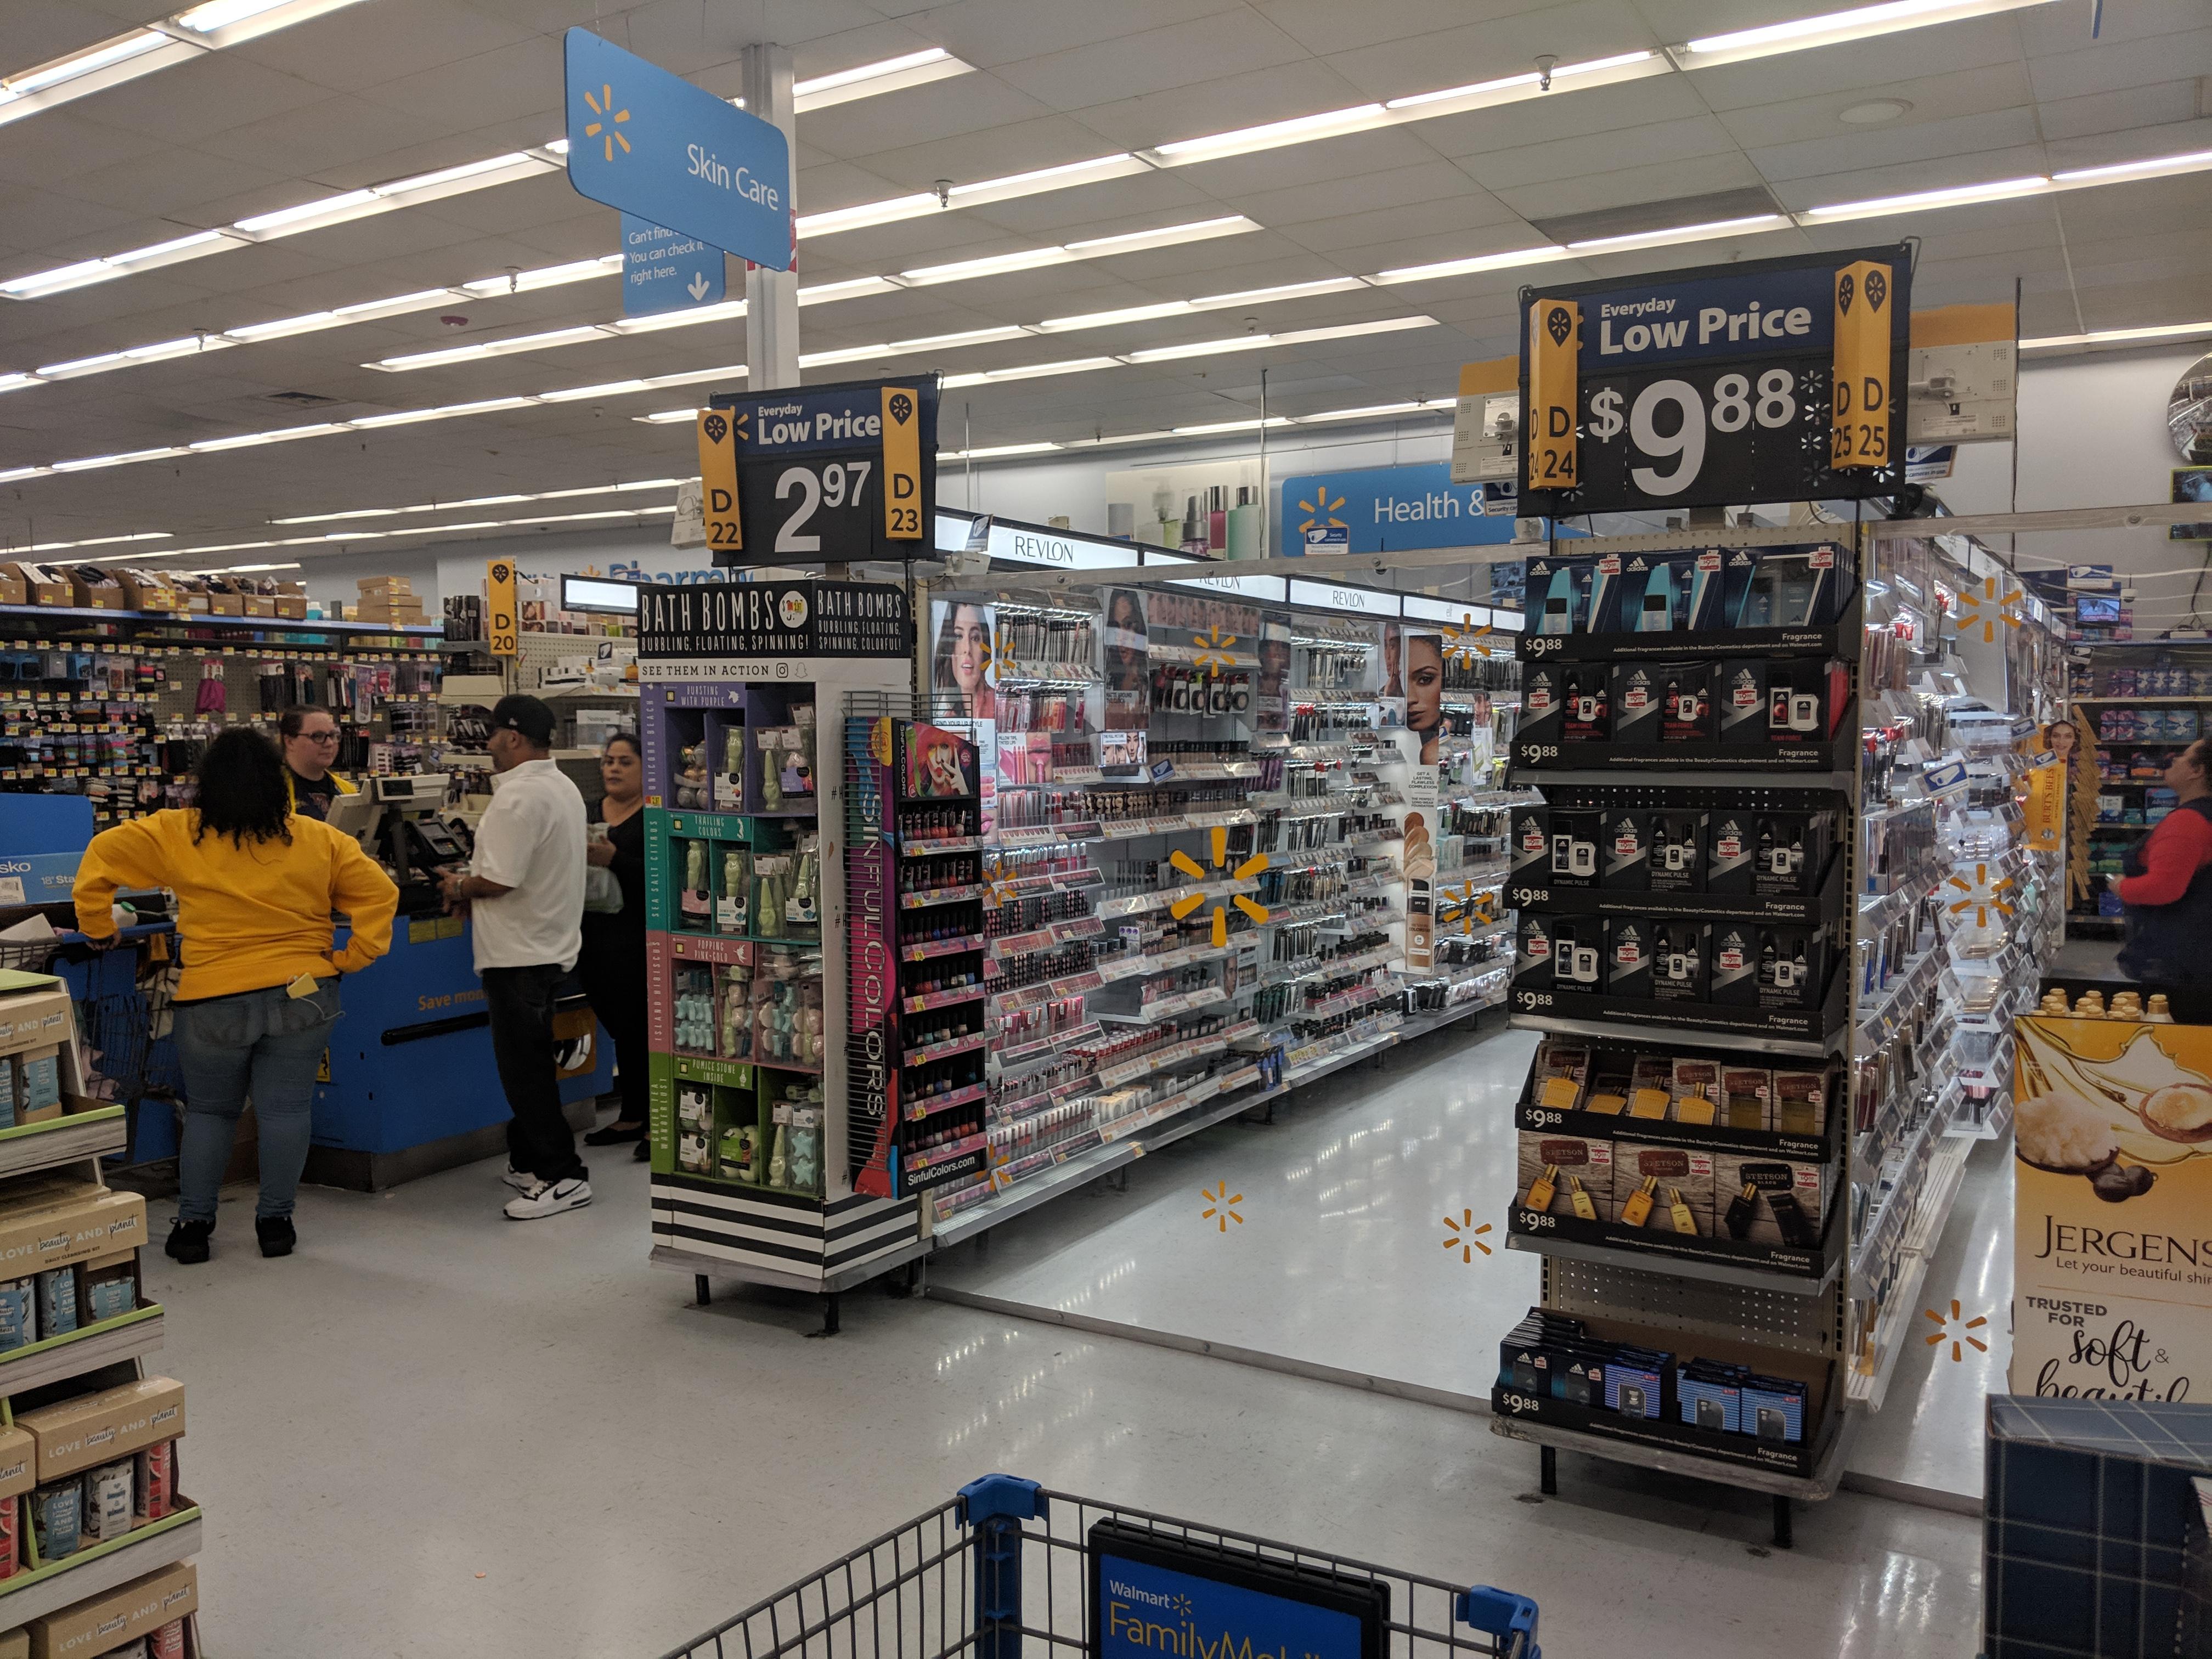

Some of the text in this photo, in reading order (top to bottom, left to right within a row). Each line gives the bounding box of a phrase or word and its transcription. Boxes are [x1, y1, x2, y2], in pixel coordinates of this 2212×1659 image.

[687, 144, 778, 211] Skin Care
[629, 229, 652, 245] Can't
[629, 252, 647, 264] You
[649, 248, 665, 260] can
[668, 240, 695, 256] check
[630, 266, 678, 285] right here.
[1601, 297, 1676, 319] Everyday
[1600, 302, 1812, 356] Low Price
[1837, 382, 1851, 416] D
[1864, 377, 1883, 411] D
[758, 404, 803, 417] Everyday
[1549, 406, 1570, 437] D
[758, 410, 881, 445] Low Price
[1532, 408, 1538, 440] D
[1833, 427, 1852, 459] 25
[1858, 426, 1884, 458] 25
[1544, 449, 1573, 479] 24
[893, 473, 914, 499] D
[711, 489, 732, 512] D
[1374, 488, 1485, 524] Health &
[891, 509, 918, 532] 23
[710, 522, 738, 544] 22
[1015, 535, 1074, 563] REVLON
[817, 590, 851, 617] BATH
[858, 592, 901, 618] BOMBS
[1333, 590, 1365, 608] REVLON
[495, 614, 510, 630] D
[642, 593, 691, 633] BATH
[702, 590, 774, 631] BOMBS
[818, 620, 860, 634] BUBBLING,
[1782, 633, 1822, 642] Fragrance
[494, 636, 514, 651] 20
[642, 634, 809, 652] BUBBLING, FLOATING, SPINNING!
[819, 636, 901, 651] SPINNING, COLORFUL!
[642, 665, 769, 675] SEE THEM IN ACTION
[681, 696, 725, 706] WITH PURPLE
[687, 686, 718, 695] BURSTING
[646, 701, 654, 735] BEACH
[1779, 749, 1819, 758] Fragrance
[647, 741, 656, 790] UNICORN
[695, 815, 725, 827] TRAILING
[698, 826, 722, 838] COLORS
[650, 821, 658, 860] CITRUS
[651, 867, 659, 891] SALT
[1765, 902, 1805, 911] Fragrance
[698, 939, 724, 951] POPPING
[418, 994, 451, 1011] Save
[654, 1002, 662, 1041] ISLAND
[1769, 1015, 1808, 1025] Fragrance
[692, 1058, 735, 1074] PUMICE STONE
[703, 1071, 724, 1083] INSIDE
[1779, 1139, 1818, 1150] Fragrance
[907, 1155, 975, 1186] SinfulColors.com
[1, 1214, 139, 1261] LOVE beauty AND planet
[1771, 1251, 1810, 1262] Fragrance
[2057, 1257, 2181, 1282] Let your beautiful
[2025, 1296, 2107, 1316] TRUSTED
[2048, 1313, 2084, 1328] FOR
[2068, 1320, 2151, 1387] soft
[2155, 1348, 2169, 1364] &
[48, 1441, 81, 1459] LOVE
[85, 1425, 116, 1445] beauty
[120, 1419, 146, 1434] AND
[150, 1403, 180, 1428] planet
[1758, 1447, 1798, 1462] Fragrance
[1109, 1580, 1170, 1609] Walmart
[59, 1632, 92, 1652] LOVE
[132, 1602, 157, 1621] AND
[162, 1583, 193, 1605] planet
